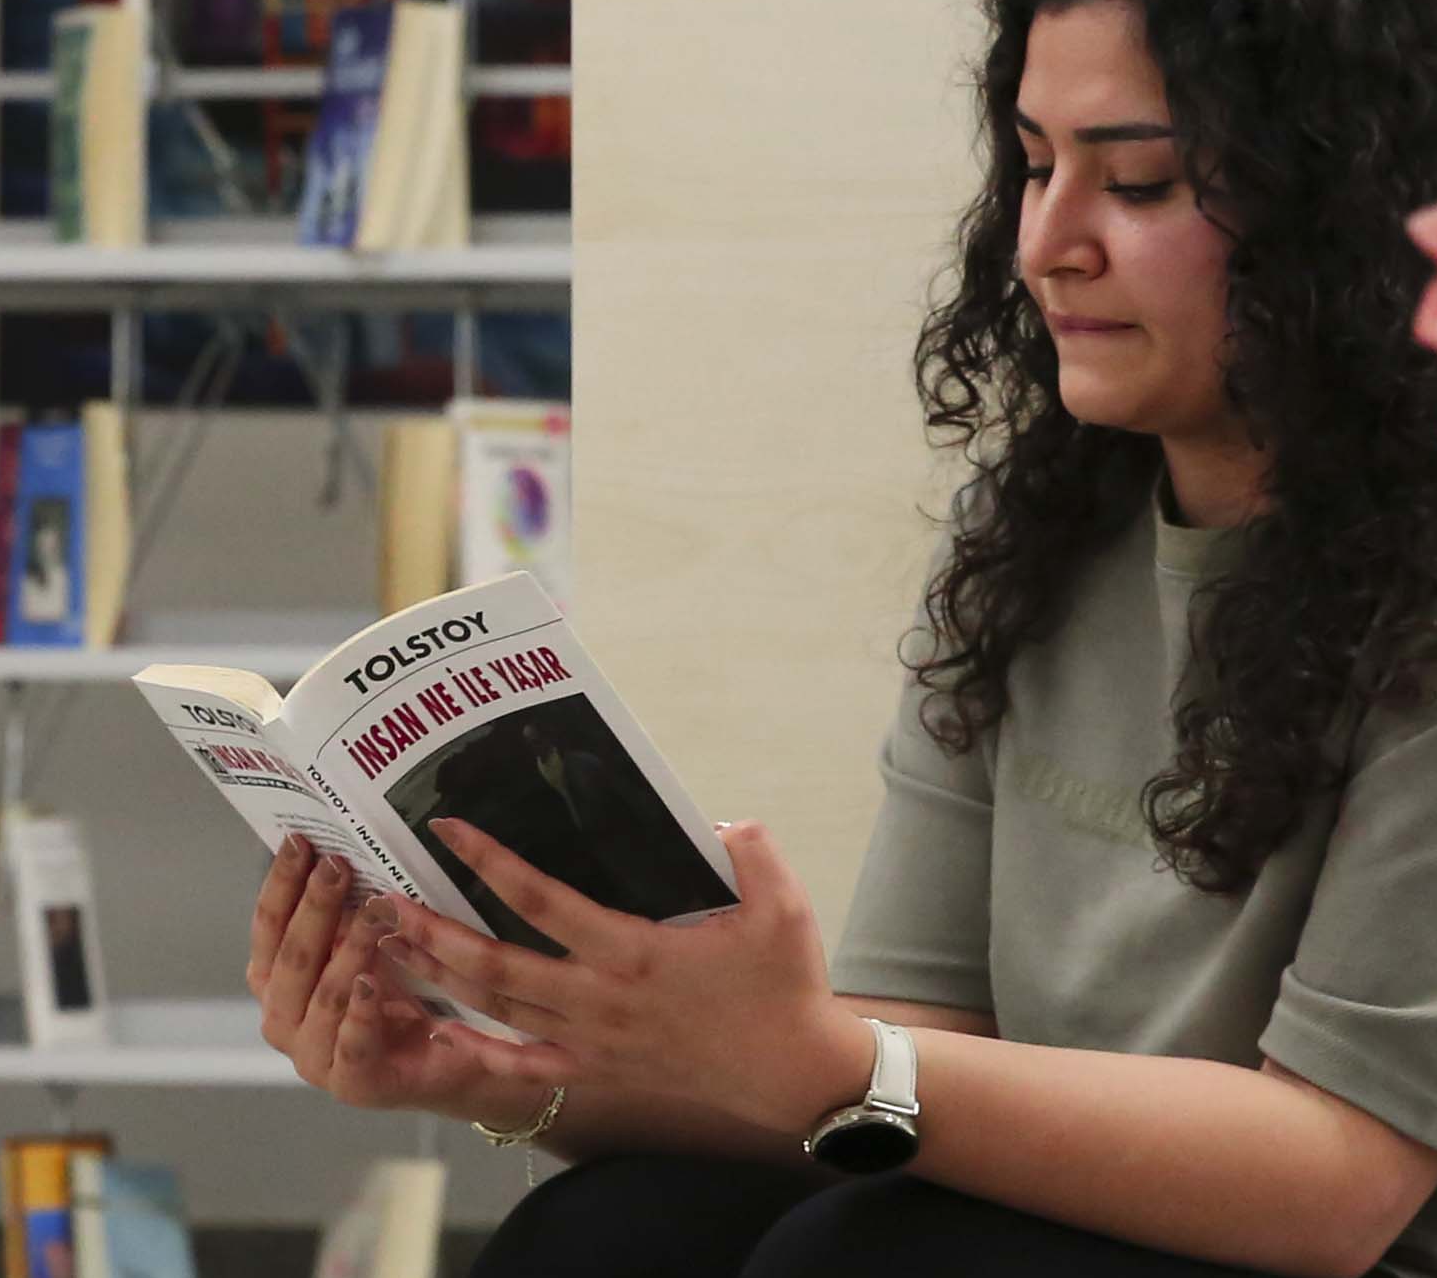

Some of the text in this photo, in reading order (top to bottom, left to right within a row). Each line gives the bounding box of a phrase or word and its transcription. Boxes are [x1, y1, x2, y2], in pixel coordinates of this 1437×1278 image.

[342, 702, 429, 781] İNSAN
[416, 682, 465, 726] NE
[445, 667, 502, 708] İLE
[487, 646, 572, 693] YAŞAR
[343, 611, 489, 694] TOLSTOY
[306, 764, 351, 815] TOLSTOY
[356, 825, 390, 865] İNSAN
[388, 865, 405, 882] NE
[403, 883, 419, 900] İLE
